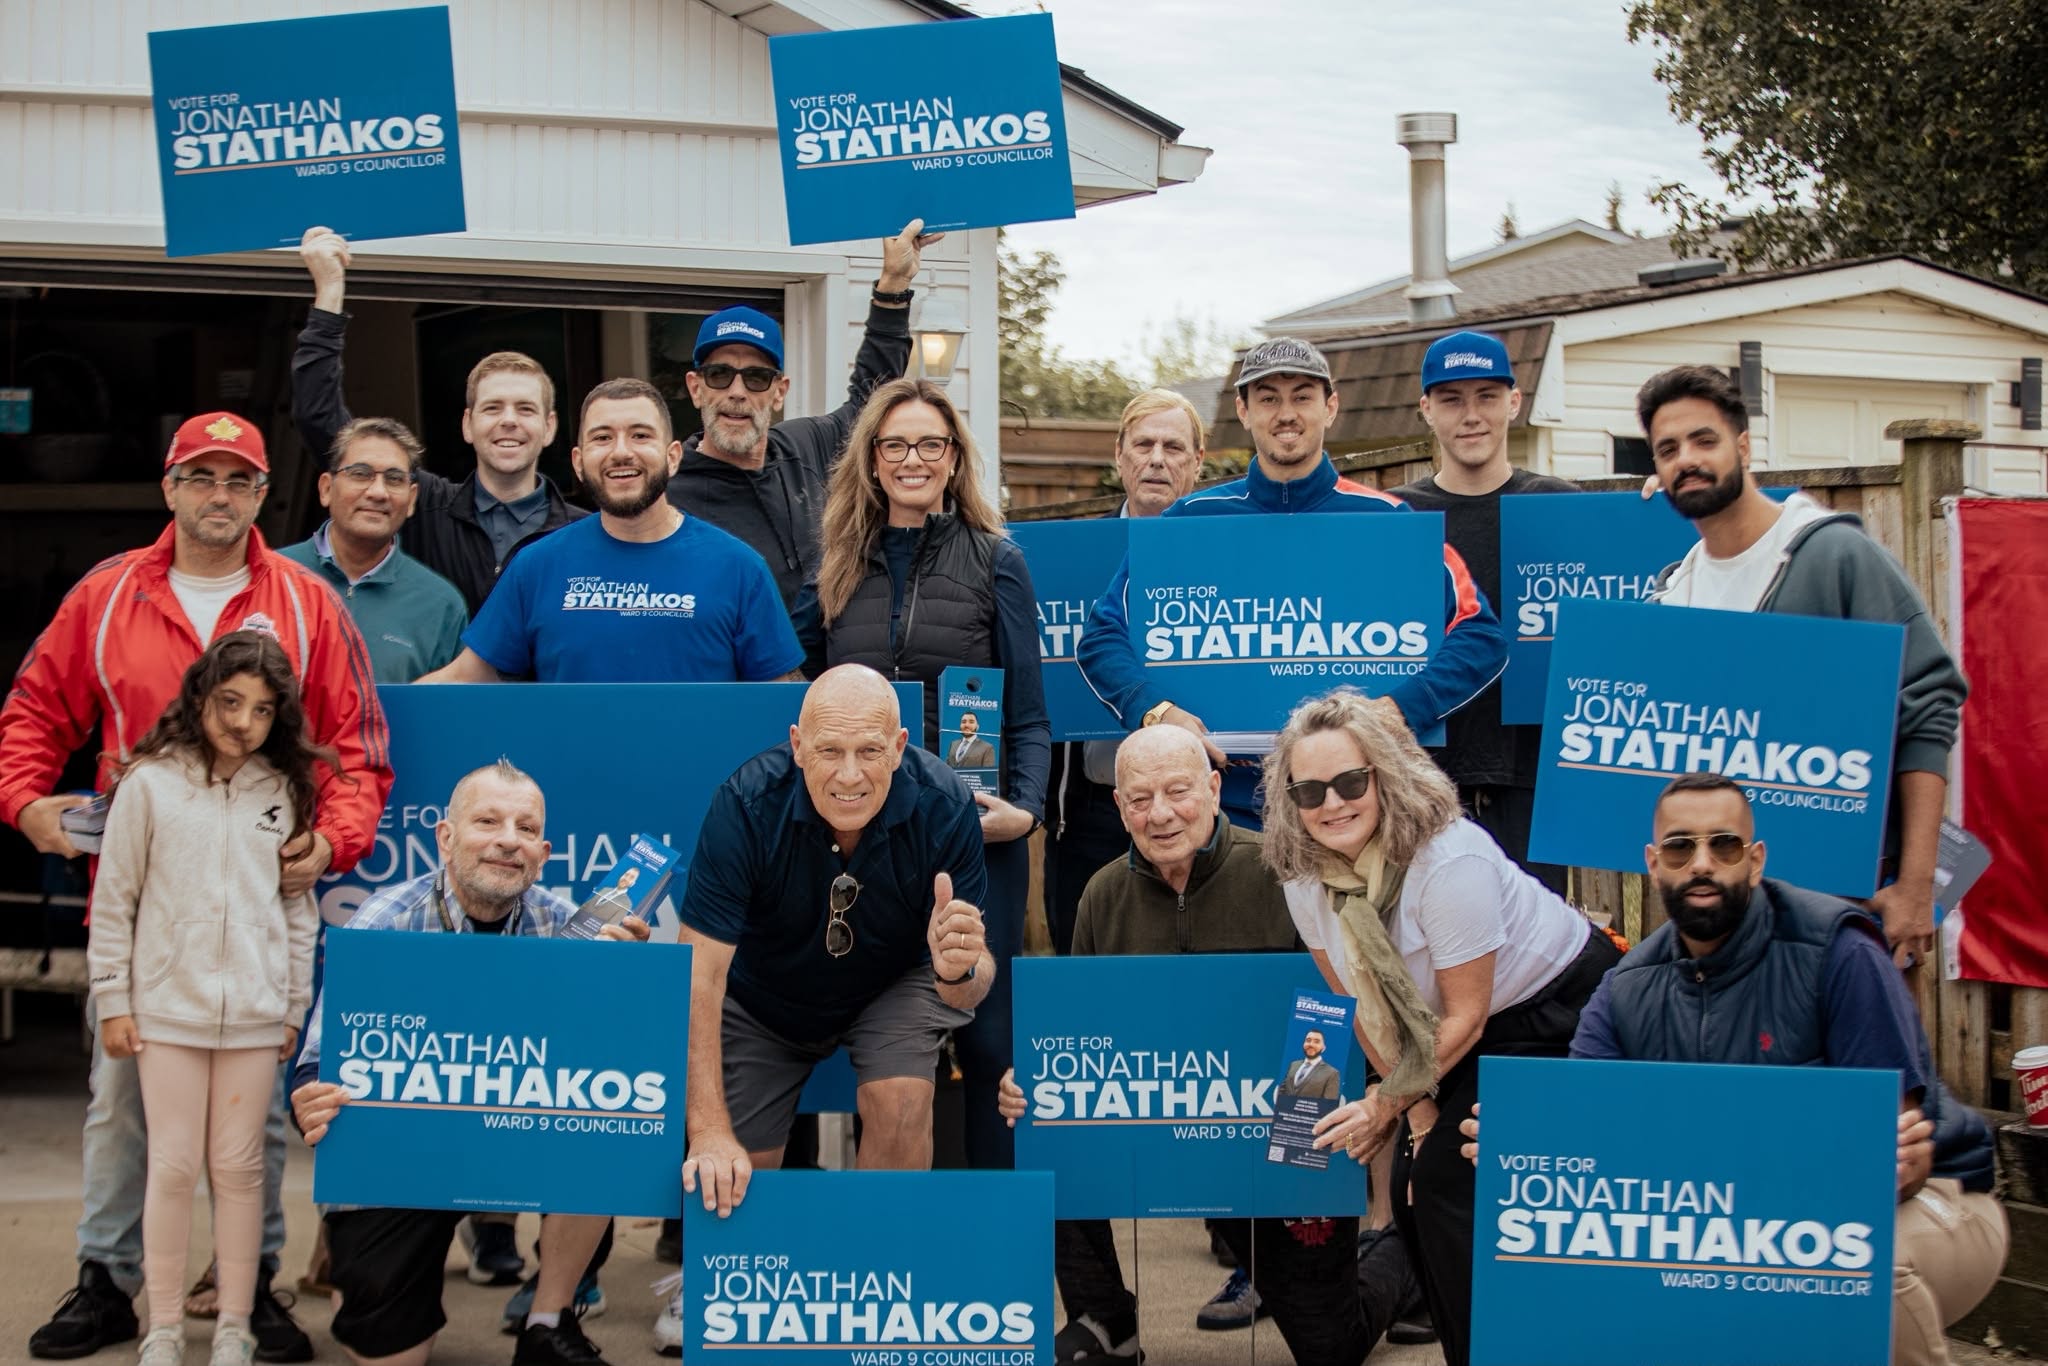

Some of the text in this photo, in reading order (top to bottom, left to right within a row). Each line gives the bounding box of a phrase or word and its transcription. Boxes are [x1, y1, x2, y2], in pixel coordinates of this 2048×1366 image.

[168, 93, 240, 110] VOTE FOR
[790, 93, 857, 110] VOTE FOR
[171, 97, 341, 136] JONATHAN
[793, 96, 954, 133] JONATHAN
[172, 114, 444, 169] STATHAKOS
[795, 111, 1051, 163] STATHAKOS
[295, 154, 446, 177] WARD 9 COUNCILLOR
[912, 148, 1053, 171] WARD 9 COUNCILLOR
[717, 325, 765, 339] STATHAKOS
[1517, 562, 1586, 576] VOTE FOR
[566, 583, 648, 593] JONATHAN
[1145, 586, 1218, 600] VOTE FOR
[1517, 575, 1658, 601] JONATHA
[563, 592, 695, 609] STATHAKOS
[1145, 597, 1322, 626] JONATHAN
[648, 611, 694, 619] COUNCILLOR
[1145, 621, 1428, 661] STATHAKOS
[1270, 664, 1314, 677] WARD
[1318, 664, 1327, 676] 9
[1567, 677, 1648, 698] VOTE FOR
[949, 699, 998, 708] STATHAKOS
[1563, 694, 1761, 740] JONATHAN
[1558, 722, 1873, 790] STATHAKOS
[1745, 789, 1868, 814] 9 COUNCILLOR
[403, 806, 451, 829] FO
[1296, 1001, 1346, 1015] STATHAKOS
[340, 1012, 427, 1030] VOTE FOR
[339, 1028, 548, 1066] JONATHAN
[1031, 1036, 1113, 1051] VOTE FOR
[1032, 1050, 1229, 1081] JONATHAN
[338, 1059, 667, 1113] STATHAKOS
[1032, 1079, 1279, 1120] STATHAK
[483, 1114, 665, 1136] WARD 9 COUNCILLOR
[1173, 1126, 1221, 1140] WARD
[1226, 1125, 1237, 1139] 9
[1498, 1154, 1597, 1174] VOTE FOR
[1497, 1174, 1735, 1215] JONATHAN
[1496, 1207, 1873, 1269] STATHAKOS
[703, 1255, 789, 1270] VOTE FOR
[703, 1271, 912, 1302] JONATHAN
[1660, 1271, 1872, 1296] WARD 9 COUNCILLOR
[703, 1301, 1036, 1343] STATHAKOS
[851, 1352, 1035, 1366] WARD 9 COUNCILLOR
